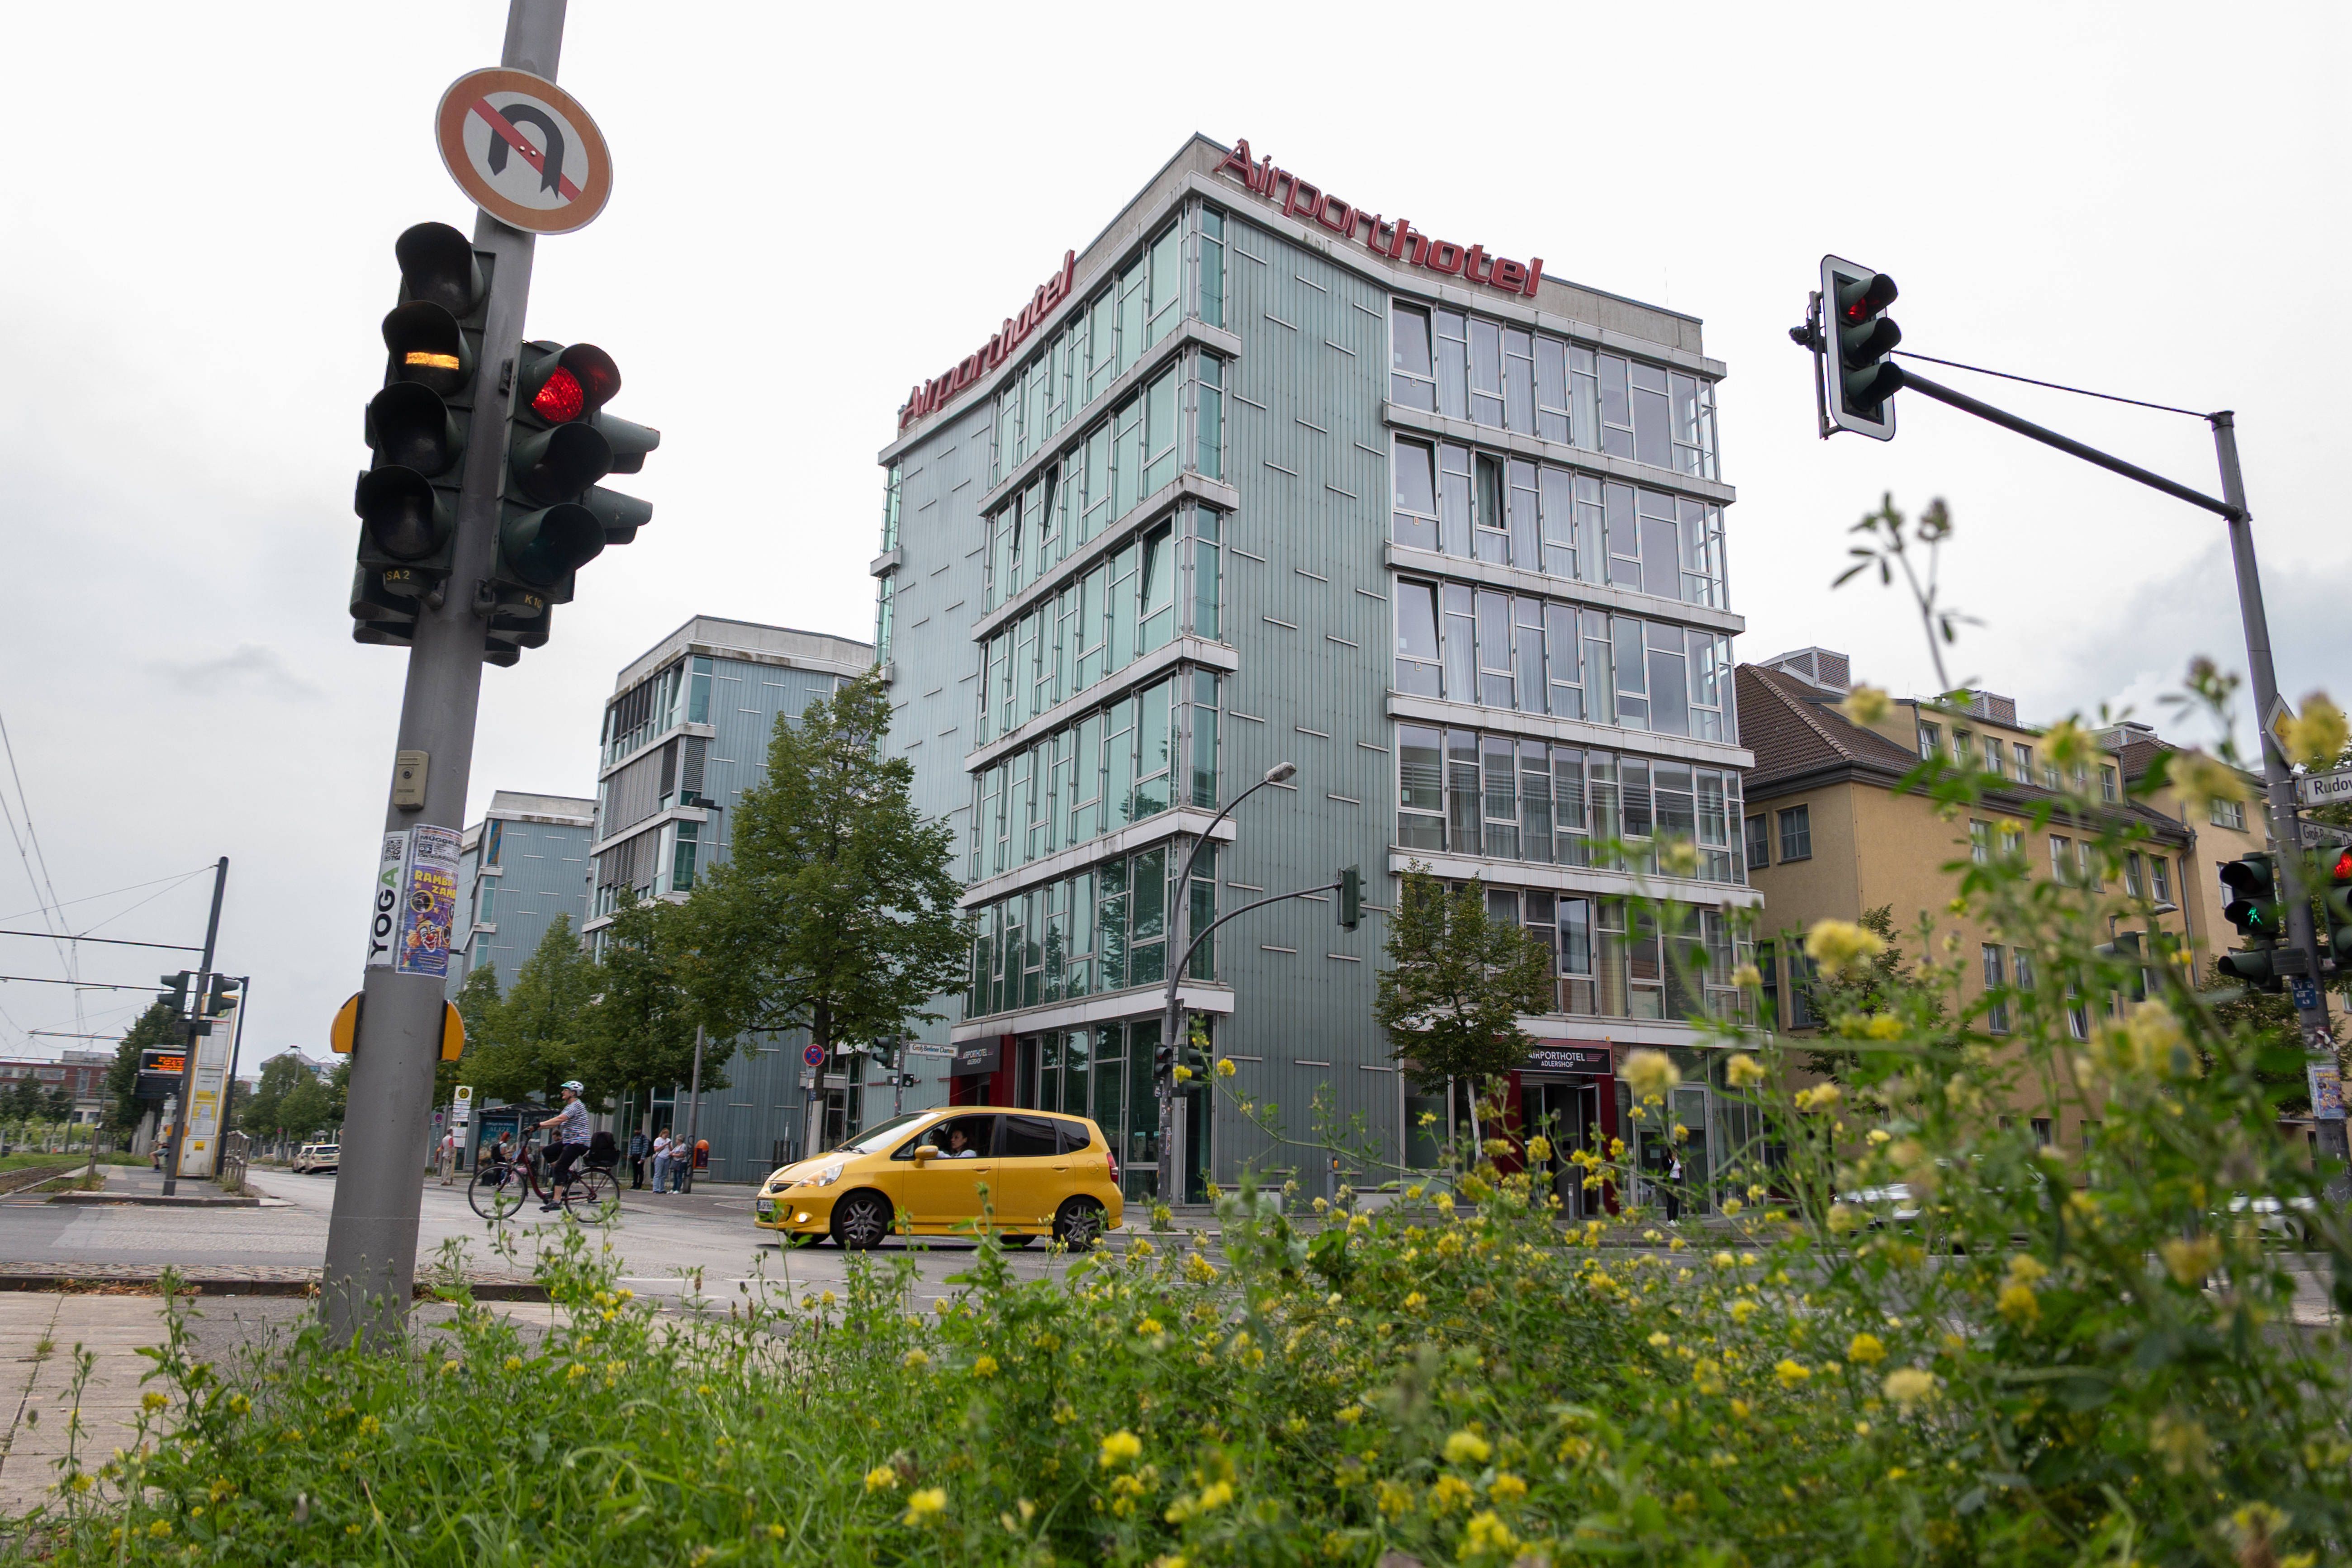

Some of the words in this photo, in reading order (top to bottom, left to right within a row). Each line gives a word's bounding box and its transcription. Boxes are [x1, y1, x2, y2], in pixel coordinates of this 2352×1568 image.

[1213, 137, 1543, 298] Airporthotel
[899, 248, 1075, 429] Airporthotel
[524, 594, 533, 605] K
[2314, 777, 2352, 795] Rudo
[370, 867, 399, 959] YOGA
